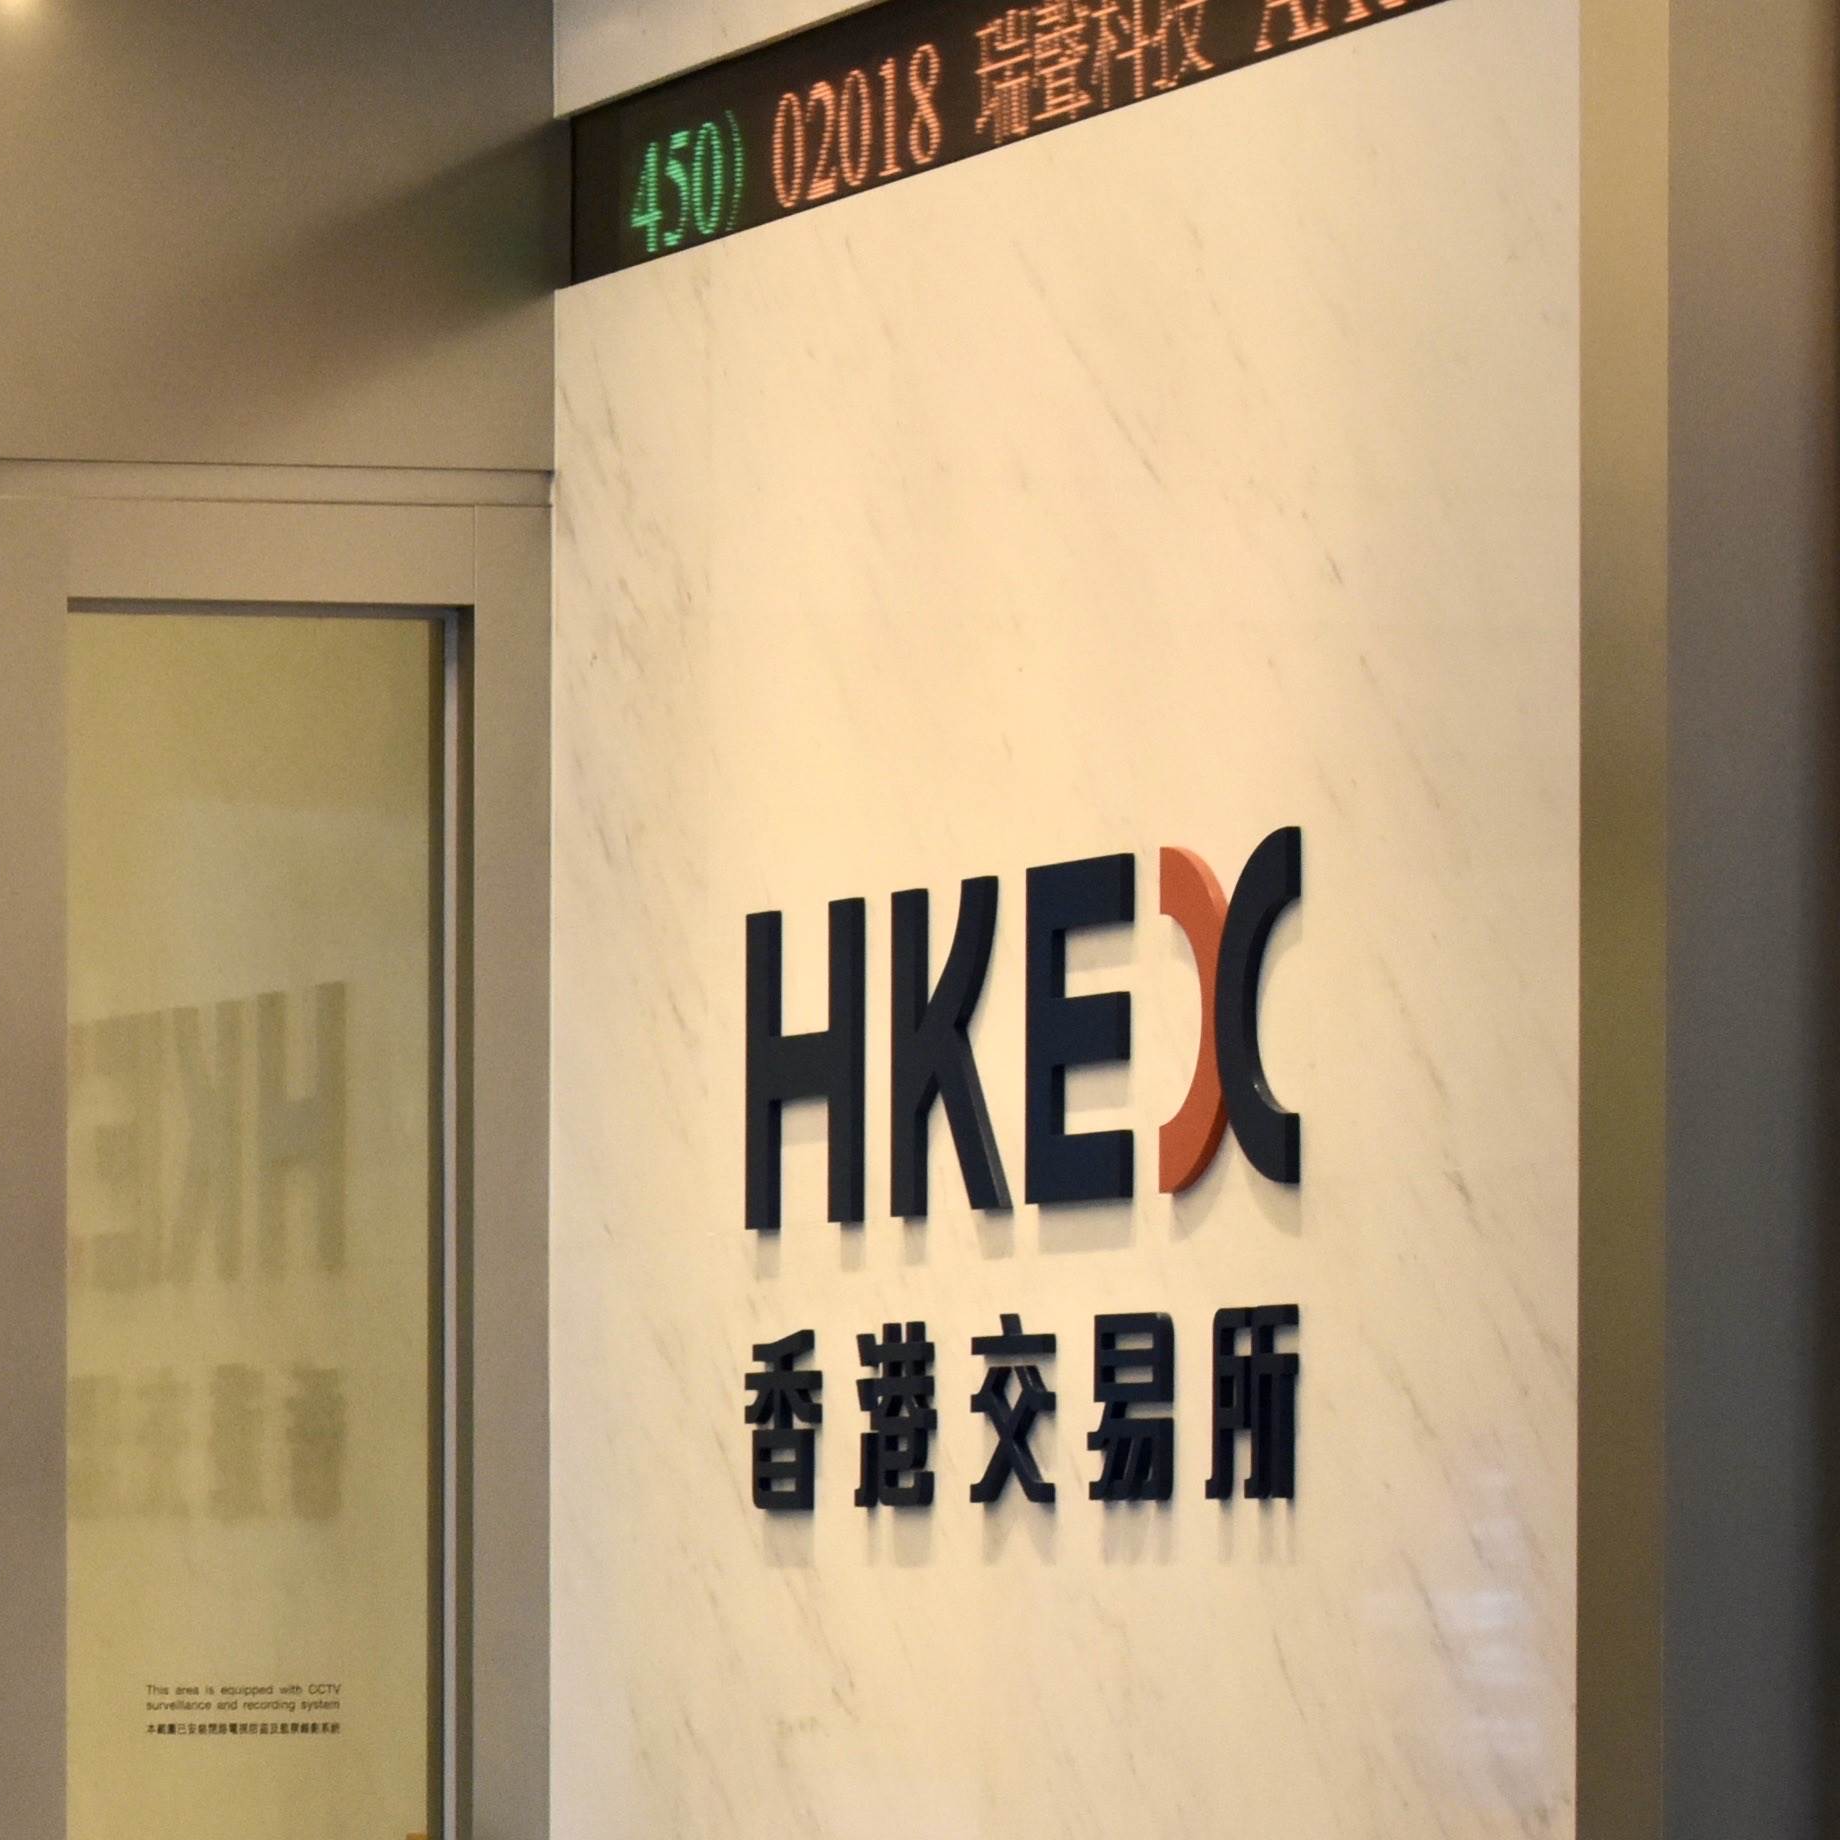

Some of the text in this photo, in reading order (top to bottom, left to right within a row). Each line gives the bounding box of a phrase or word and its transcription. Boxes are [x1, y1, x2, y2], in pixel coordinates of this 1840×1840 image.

[772, 43, 943, 208] 02018
[745, 826, 1301, 1230] HKEX
[745, 1304, 1299, 1509] 香港交易所
[146, 1684, 342, 1699] This area is equipped with CCTV
[146, 1699, 340, 1713] surveillance and recording system
